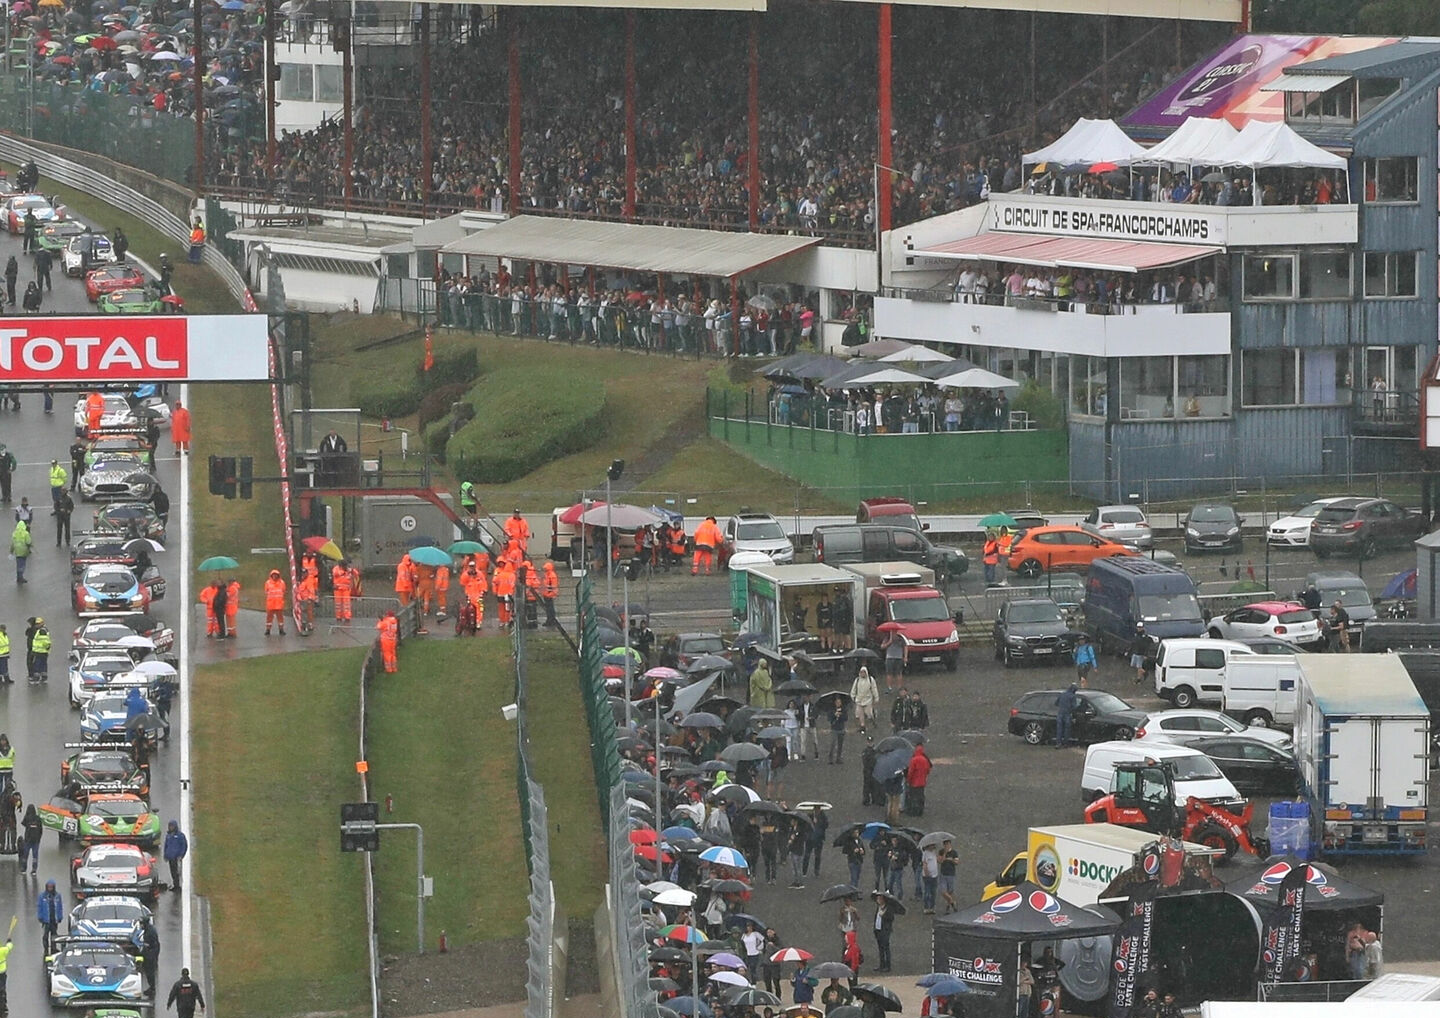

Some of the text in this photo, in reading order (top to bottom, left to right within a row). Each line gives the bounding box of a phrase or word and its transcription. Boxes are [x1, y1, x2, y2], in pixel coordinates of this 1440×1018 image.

[1004, 207, 1049, 227] CIRCUIT
[1053, 210, 1068, 229] DE
[65, 821, 76, 832] 63
[1142, 901, 1152, 948] CHALLENGE
[1294, 887, 1304, 932] CHALLENGE
[948, 959, 973, 970] TAKE THE
[1275, 927, 1286, 973] CHALLENGE
[949, 968, 1003, 983] TASTE CHALLENGE
[1125, 936, 1139, 1007] TASTE CHALLENGE
